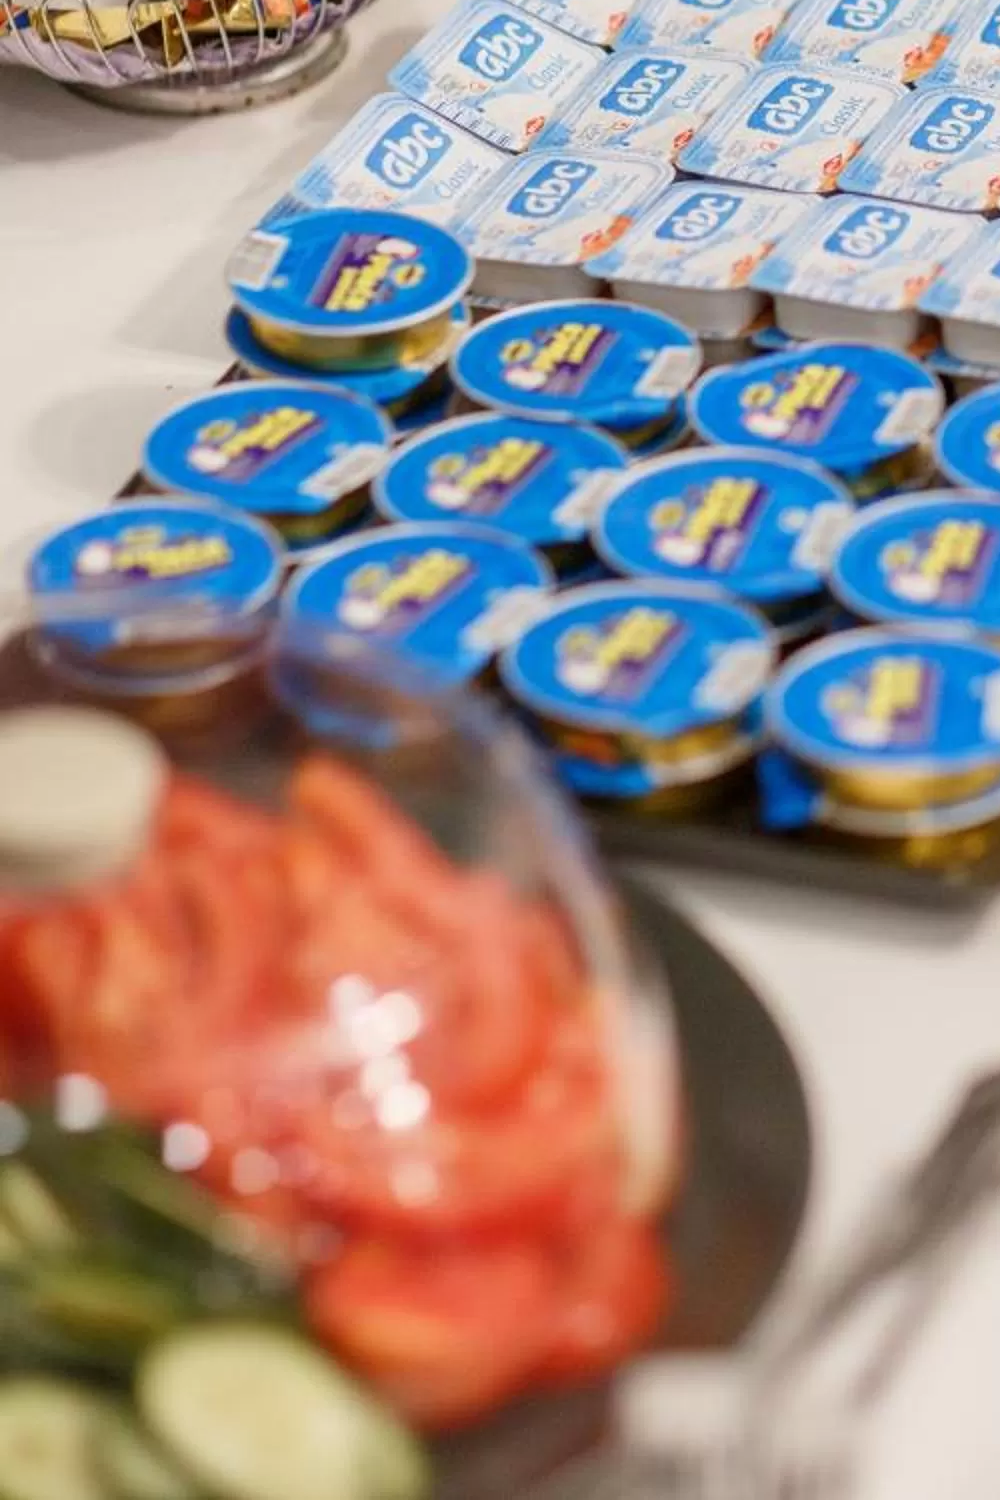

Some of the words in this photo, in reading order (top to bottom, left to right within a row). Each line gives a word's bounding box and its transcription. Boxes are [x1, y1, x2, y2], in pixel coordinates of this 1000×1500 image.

[475, 21, 536, 78] abc
[616, 62, 677, 112] abc
[763, 80, 826, 130] abc
[923, 102, 986, 150] abc
[381, 121, 444, 186] abc
[523, 164, 588, 214] abc
[671, 195, 735, 238] abc
[838, 210, 900, 257] abc
